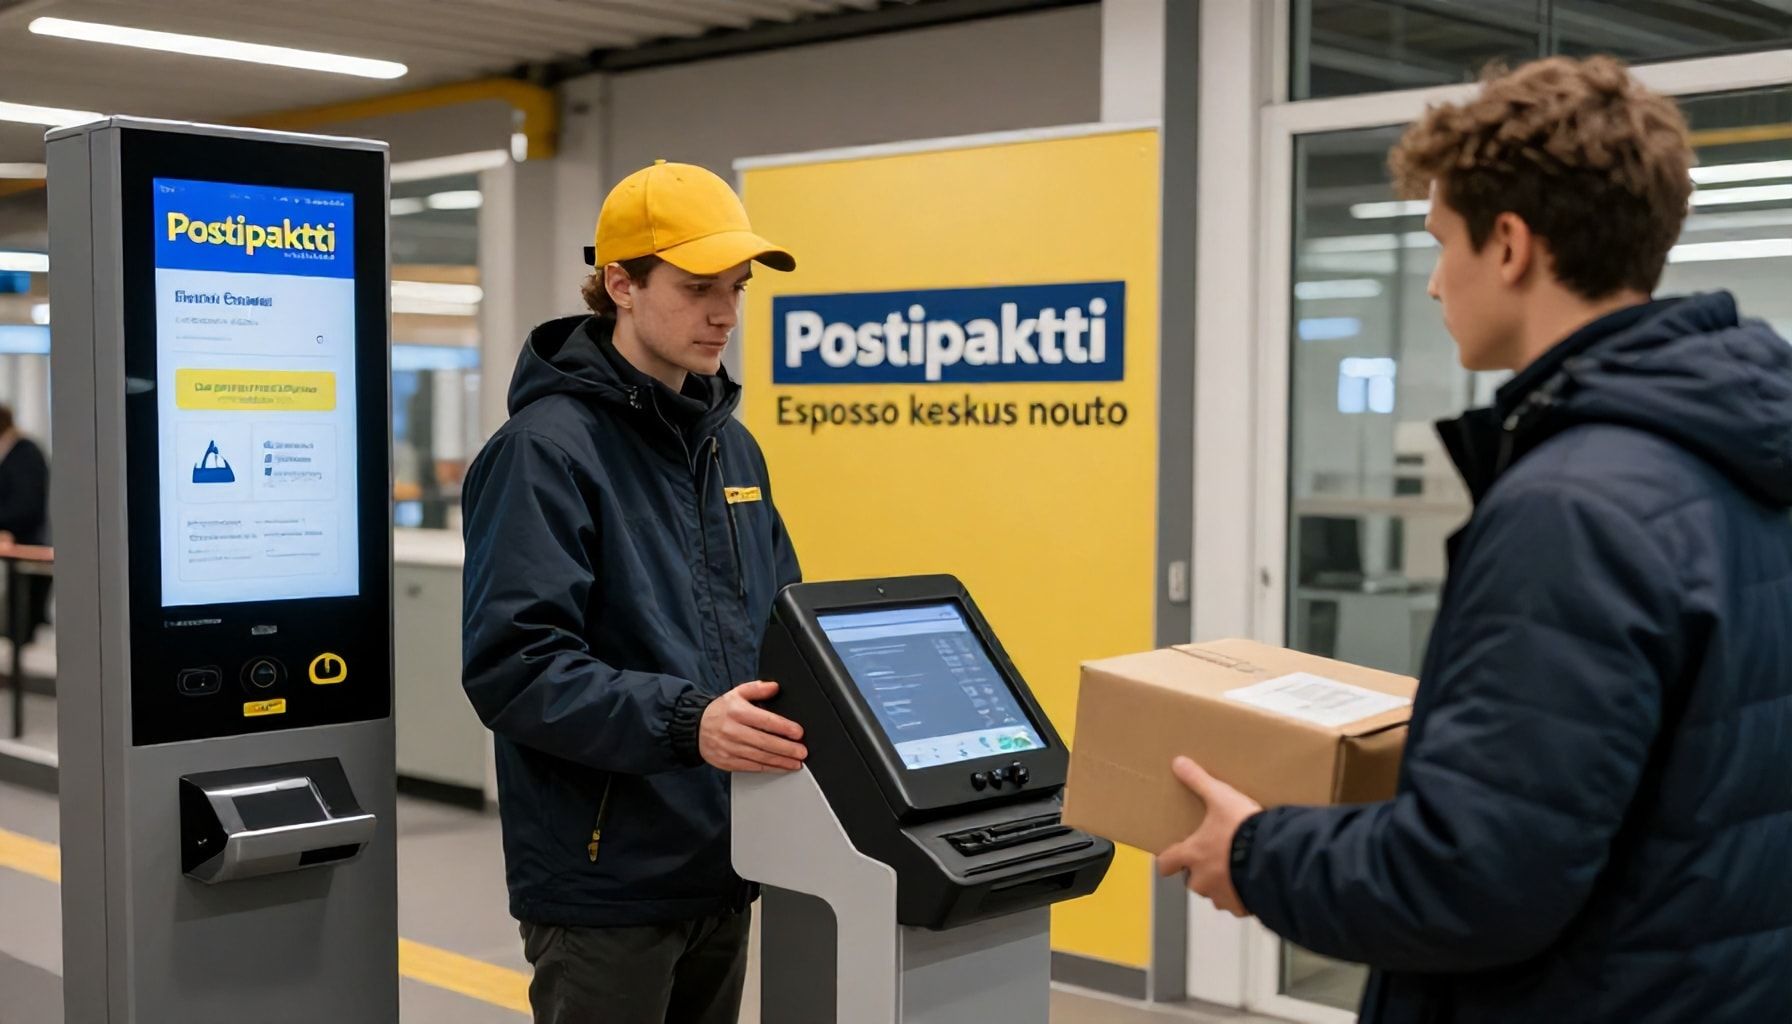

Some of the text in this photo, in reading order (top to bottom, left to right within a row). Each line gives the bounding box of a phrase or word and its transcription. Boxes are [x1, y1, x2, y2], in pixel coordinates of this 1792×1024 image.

[167, 212, 336, 255] Postipaktti
[784, 298, 1107, 381] Postipaktti
[777, 394, 1128, 434] Esposso keskus nouto
